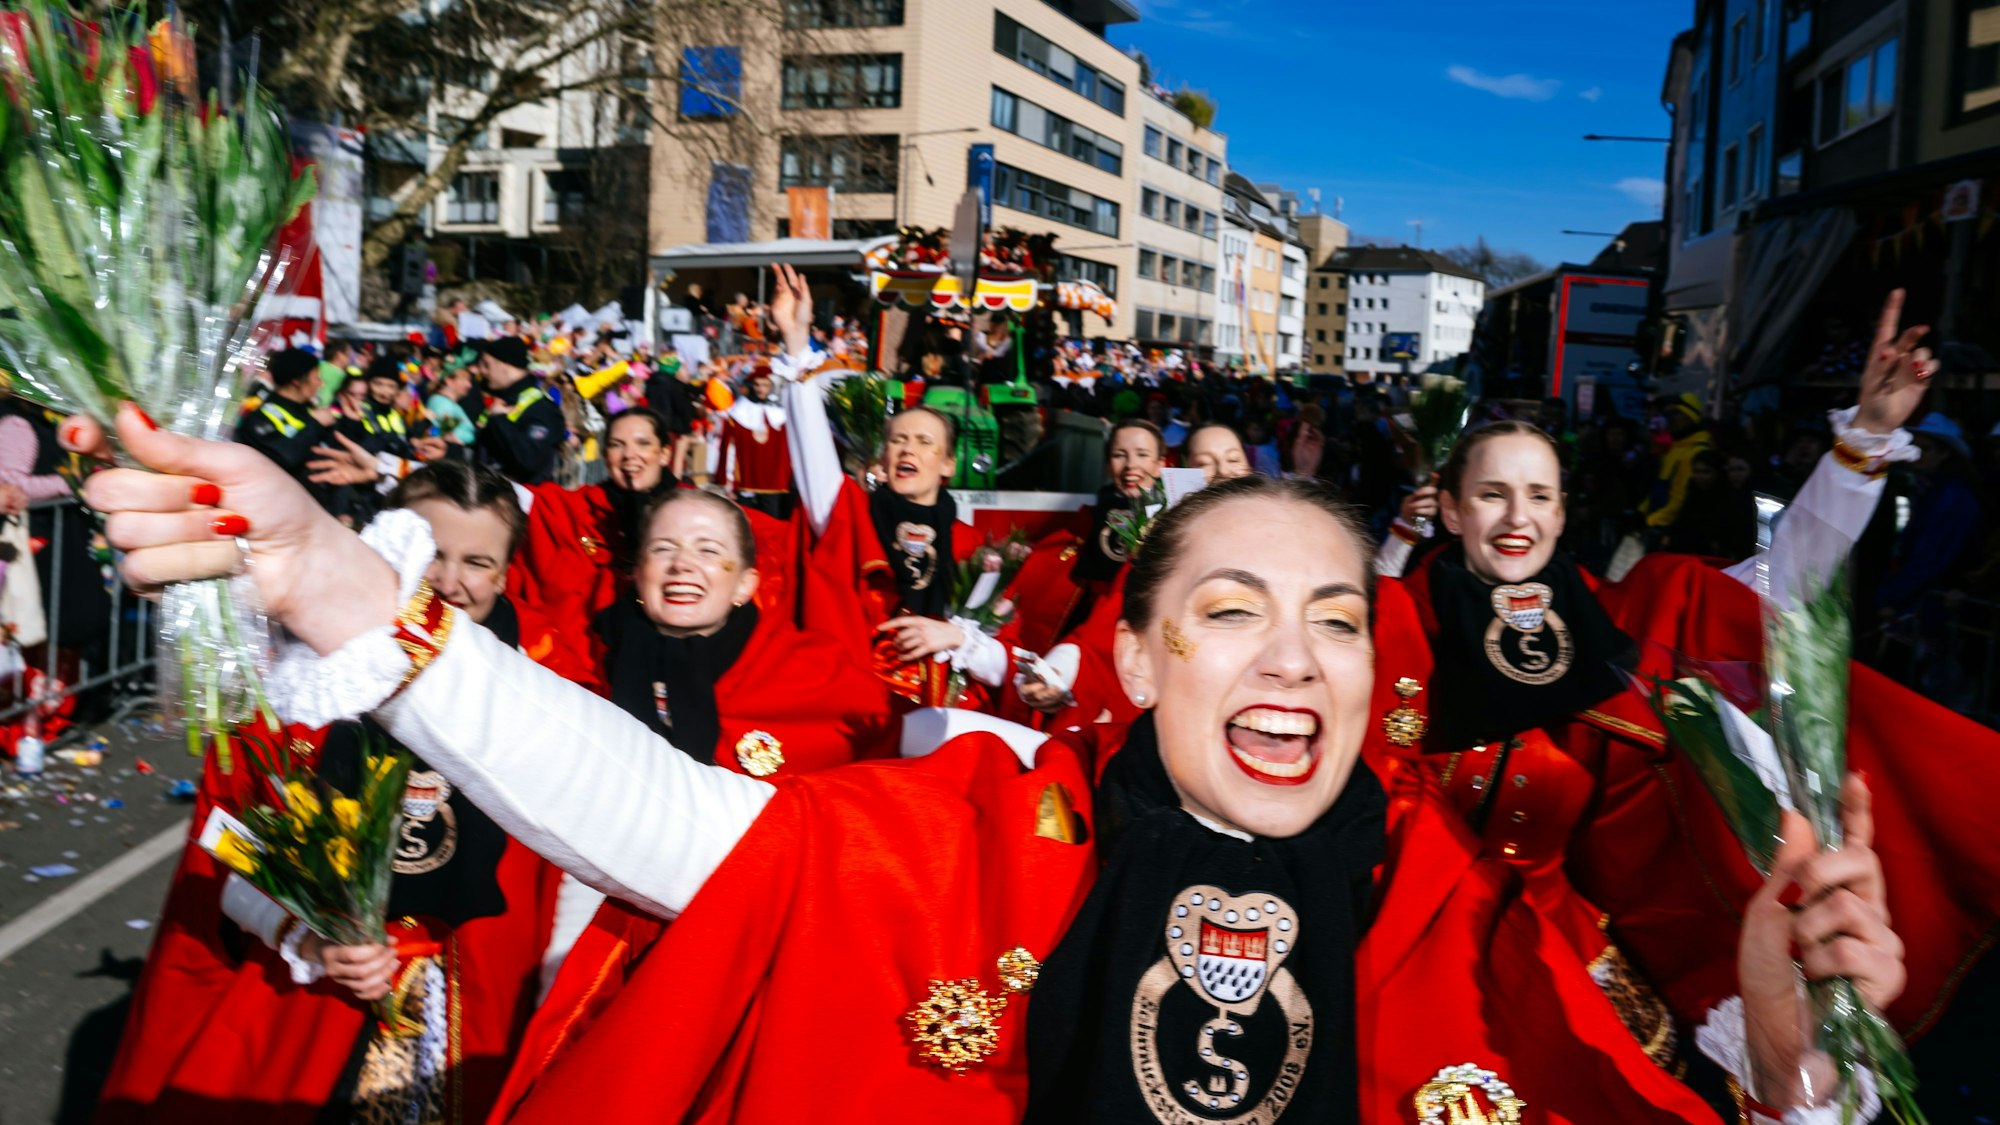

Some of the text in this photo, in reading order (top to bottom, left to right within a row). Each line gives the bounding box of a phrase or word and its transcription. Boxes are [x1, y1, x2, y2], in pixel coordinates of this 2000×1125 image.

[1519, 633, 1551, 671] S
[396, 821, 428, 858] S
[1182, 1017, 1251, 1110] S
[1265, 1062, 1300, 1118] 2008
